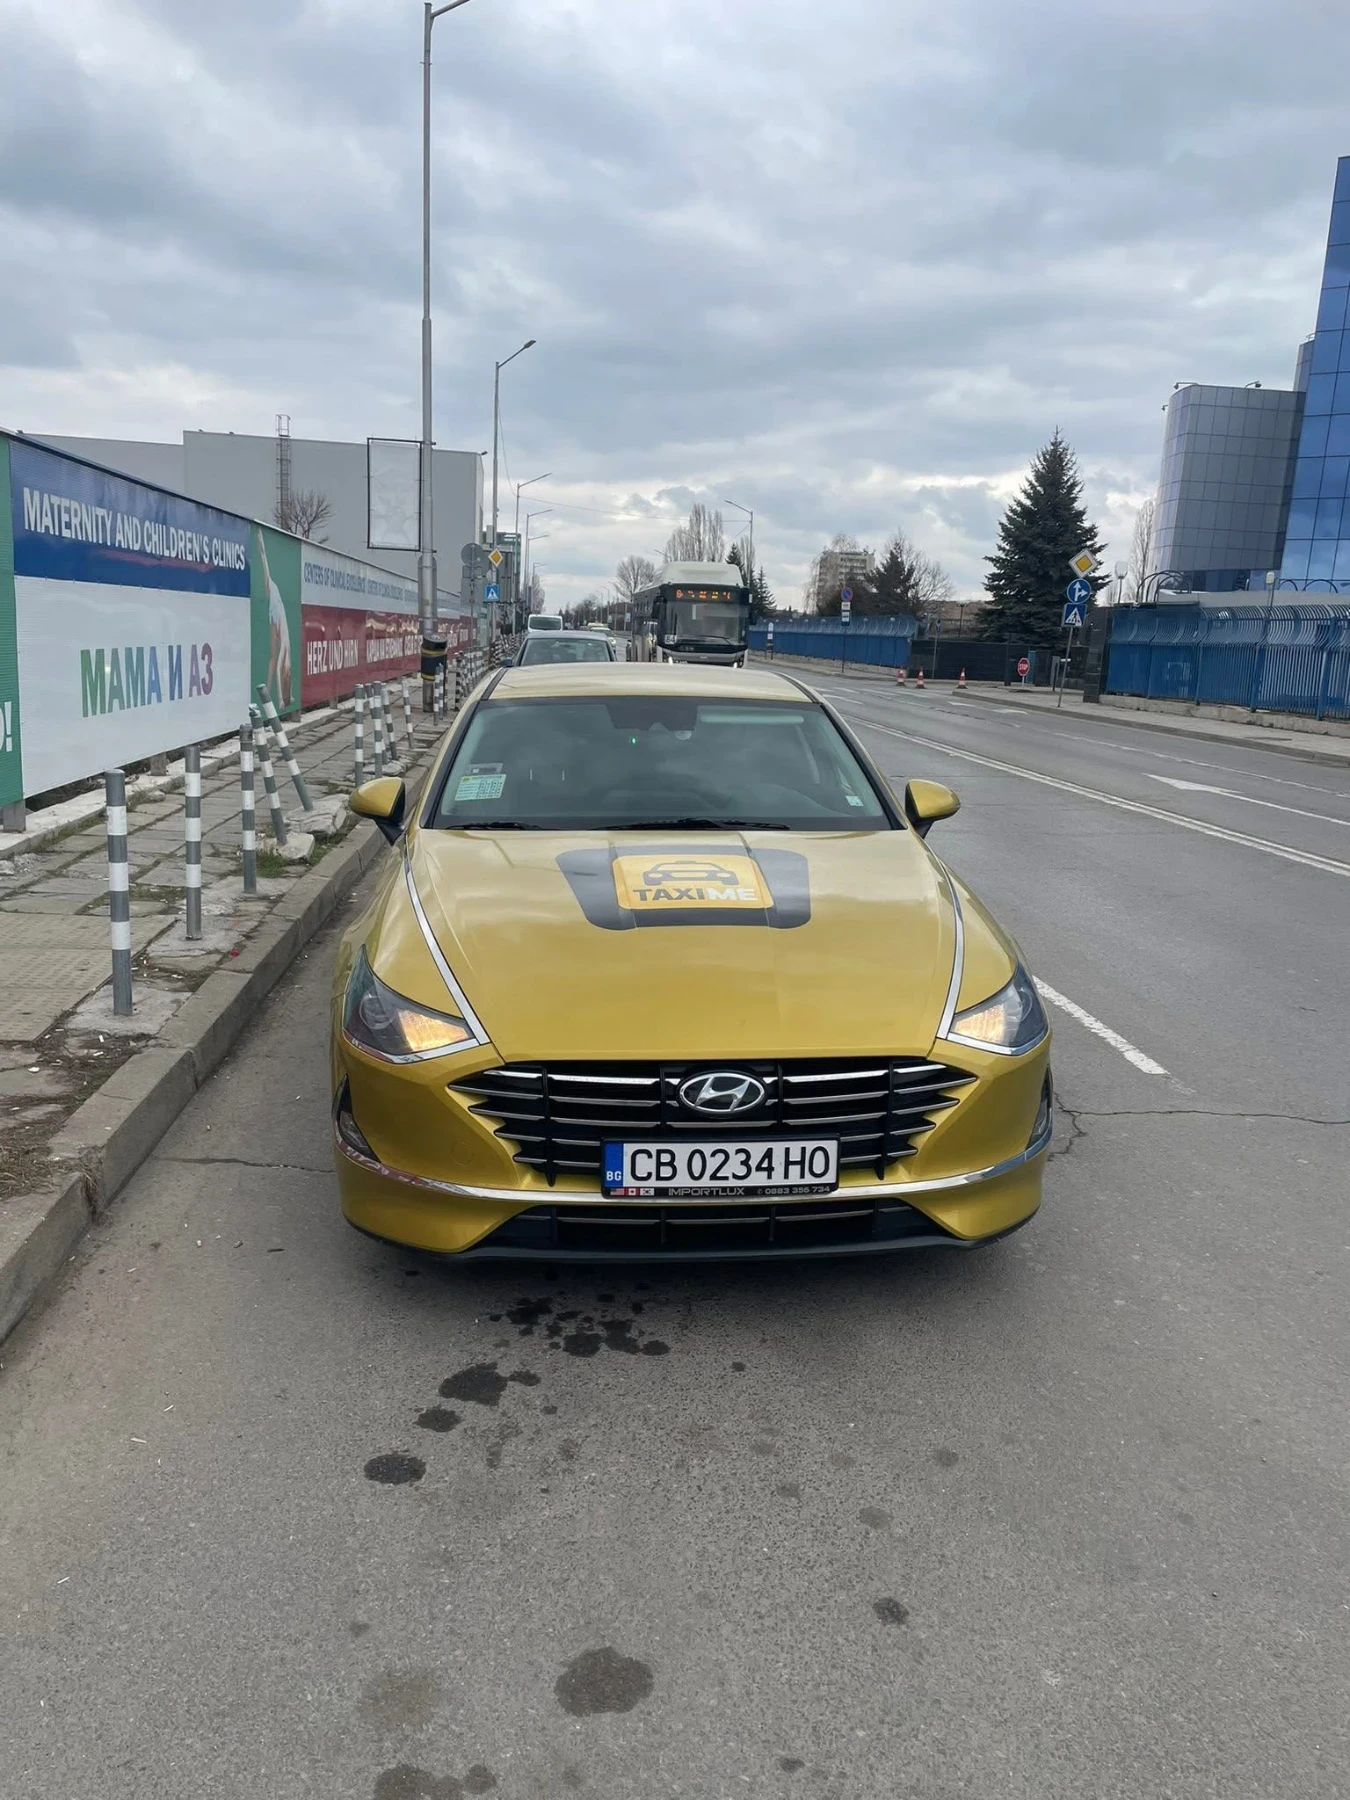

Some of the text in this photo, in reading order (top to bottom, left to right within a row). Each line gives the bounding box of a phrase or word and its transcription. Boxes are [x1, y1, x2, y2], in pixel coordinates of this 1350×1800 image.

[23, 487, 246, 571] MATERNITY AND CHILDREN'S CLINICS
[307, 640, 328, 676] HERZ
[328, 640, 344, 671] UND
[80, 642, 214, 718] МАМА И АЗ
[633, 886, 758, 901] TAXIME
[606, 1170, 622, 1182] BG
[630, 1145, 831, 1182] CB 0234 HO
[668, 1187, 746, 1197] IMPORTLUX
[764, 1187, 790, 1195] 0883
[812, 1185, 831, 1193] 734
